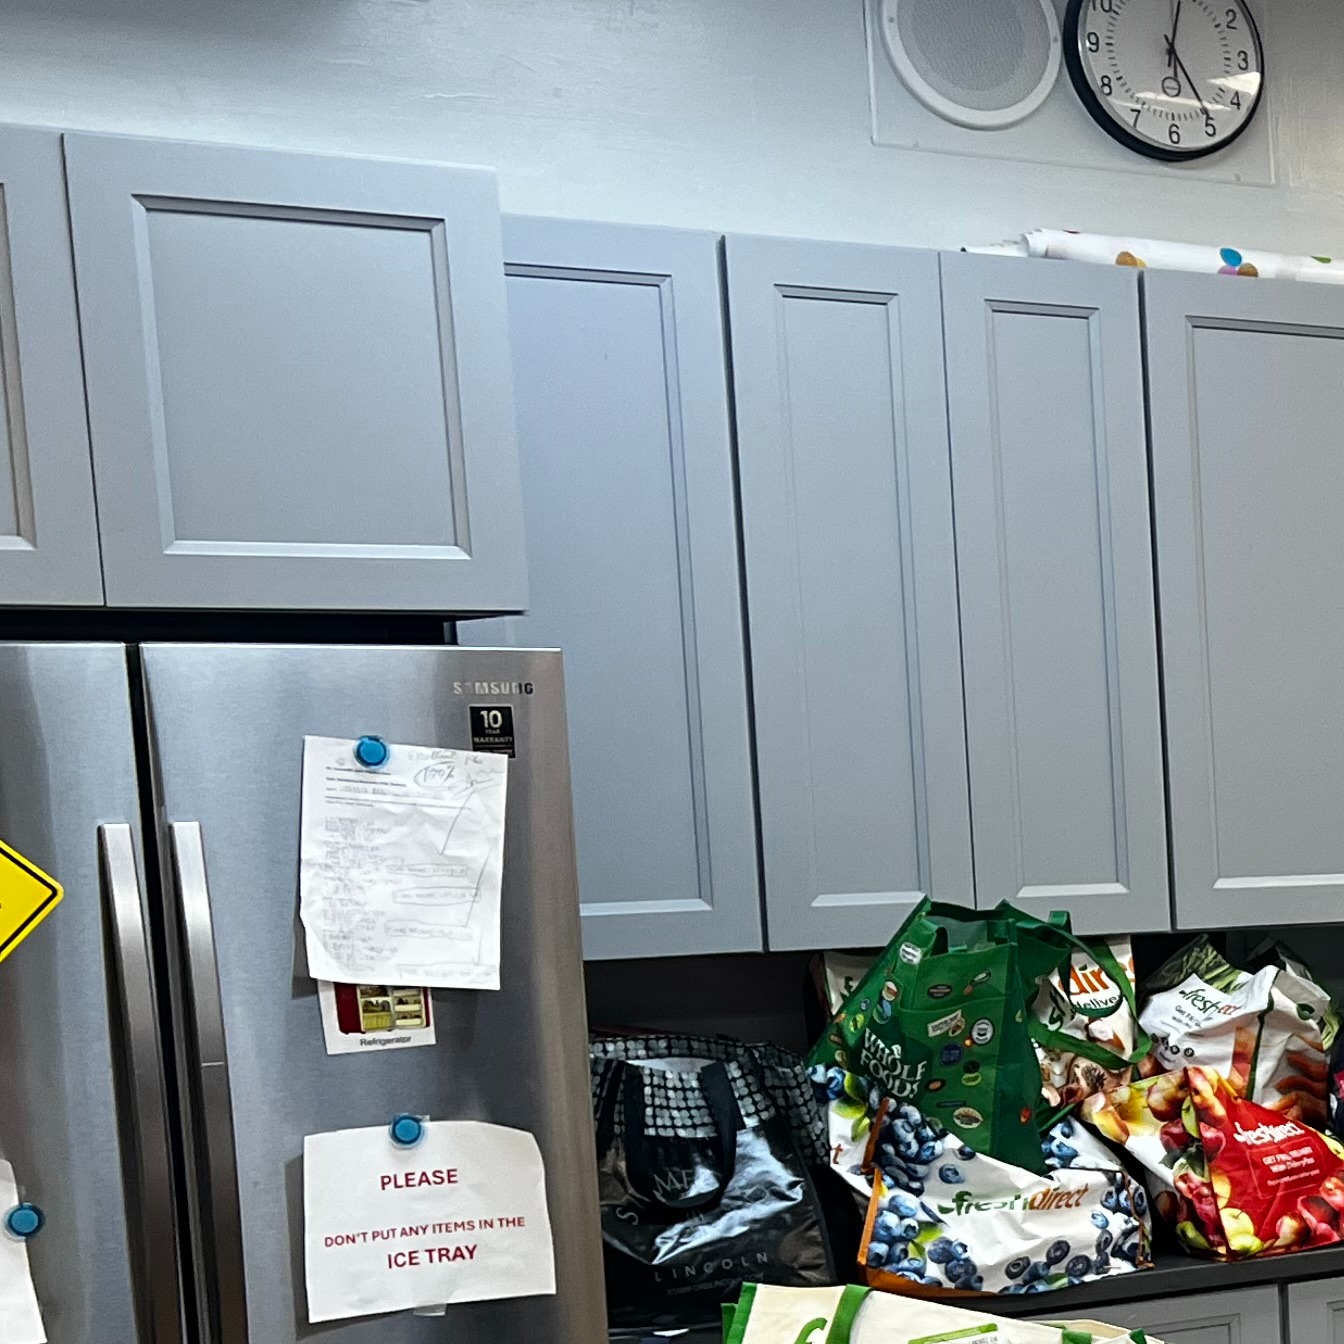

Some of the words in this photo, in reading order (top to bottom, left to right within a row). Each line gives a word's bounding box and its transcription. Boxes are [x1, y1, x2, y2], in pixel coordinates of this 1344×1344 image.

[1225, 8, 1239, 31] 2
[1086, 31, 1101, 54] 9
[1236, 50, 1250, 72] 3
[1099, 75, 1113, 97] 8
[1229, 90, 1243, 112] 4
[1129, 108, 1143, 128] 7
[1203, 116, 1217, 138] 5
[1168, 123, 1181, 146] 6
[480, 709, 503, 728] 10
[360, 1035, 412, 1047] Refrigerator
[864, 1027, 928, 1082] WHOLE
[860, 1048, 921, 1099] FOODS
[380, 1168, 459, 1191] PLEASE
[323, 1230, 369, 1248] DON'T
[371, 1227, 397, 1242] PUT
[399, 1223, 430, 1238] ANY
[431, 1219, 476, 1235] ITEMS
[478, 1217, 494, 1230] IN
[496, 1216, 526, 1229] THE
[386, 1250, 421, 1269] ICE
[424, 1243, 478, 1265] TRAY
[654, 1251, 768, 1282] LINCOLN
